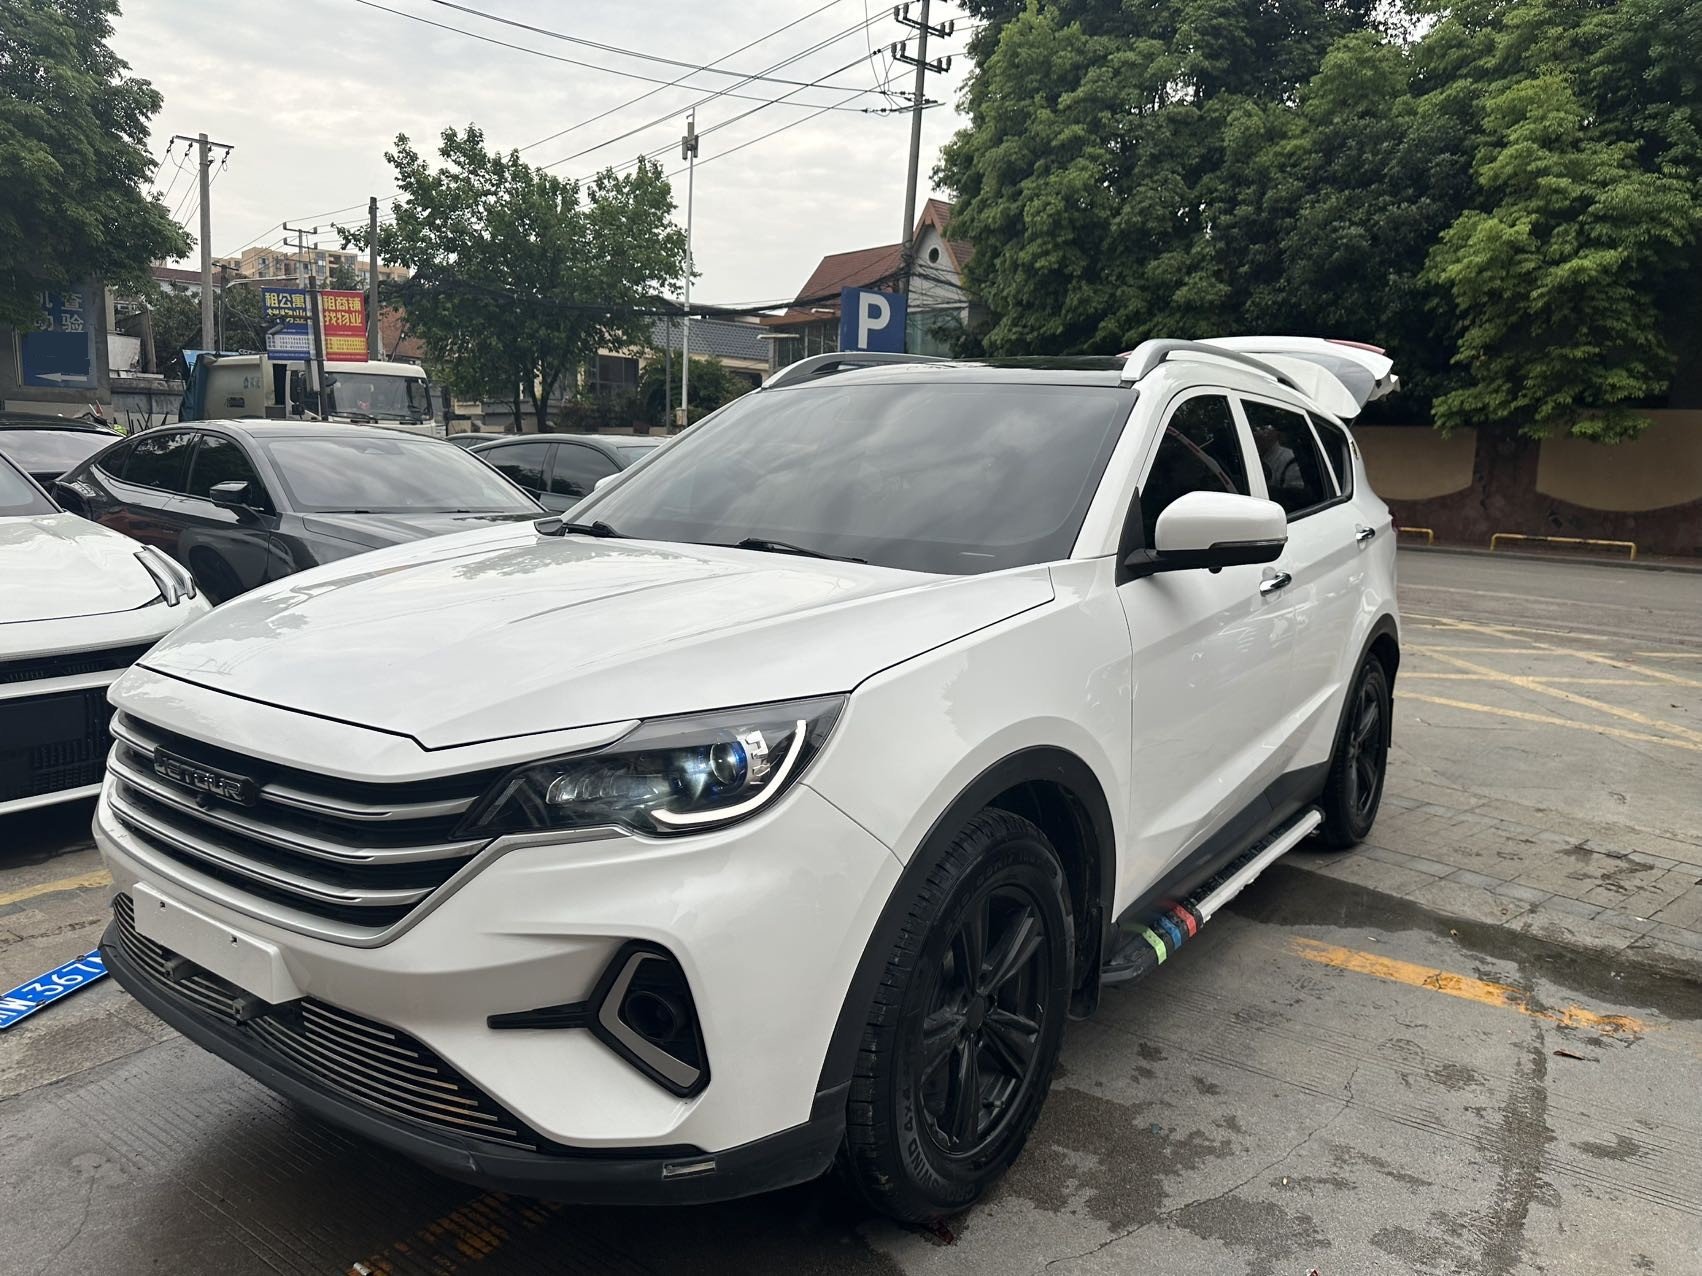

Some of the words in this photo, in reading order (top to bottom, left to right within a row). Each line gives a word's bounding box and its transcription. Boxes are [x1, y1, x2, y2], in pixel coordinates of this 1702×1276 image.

[265, 292, 305, 308] 租公寓
[323, 295, 361, 311] 租商铺
[325, 312, 363, 327] 找物业
[858, 291, 891, 350] P
[154, 757, 242, 800] JETOUR
